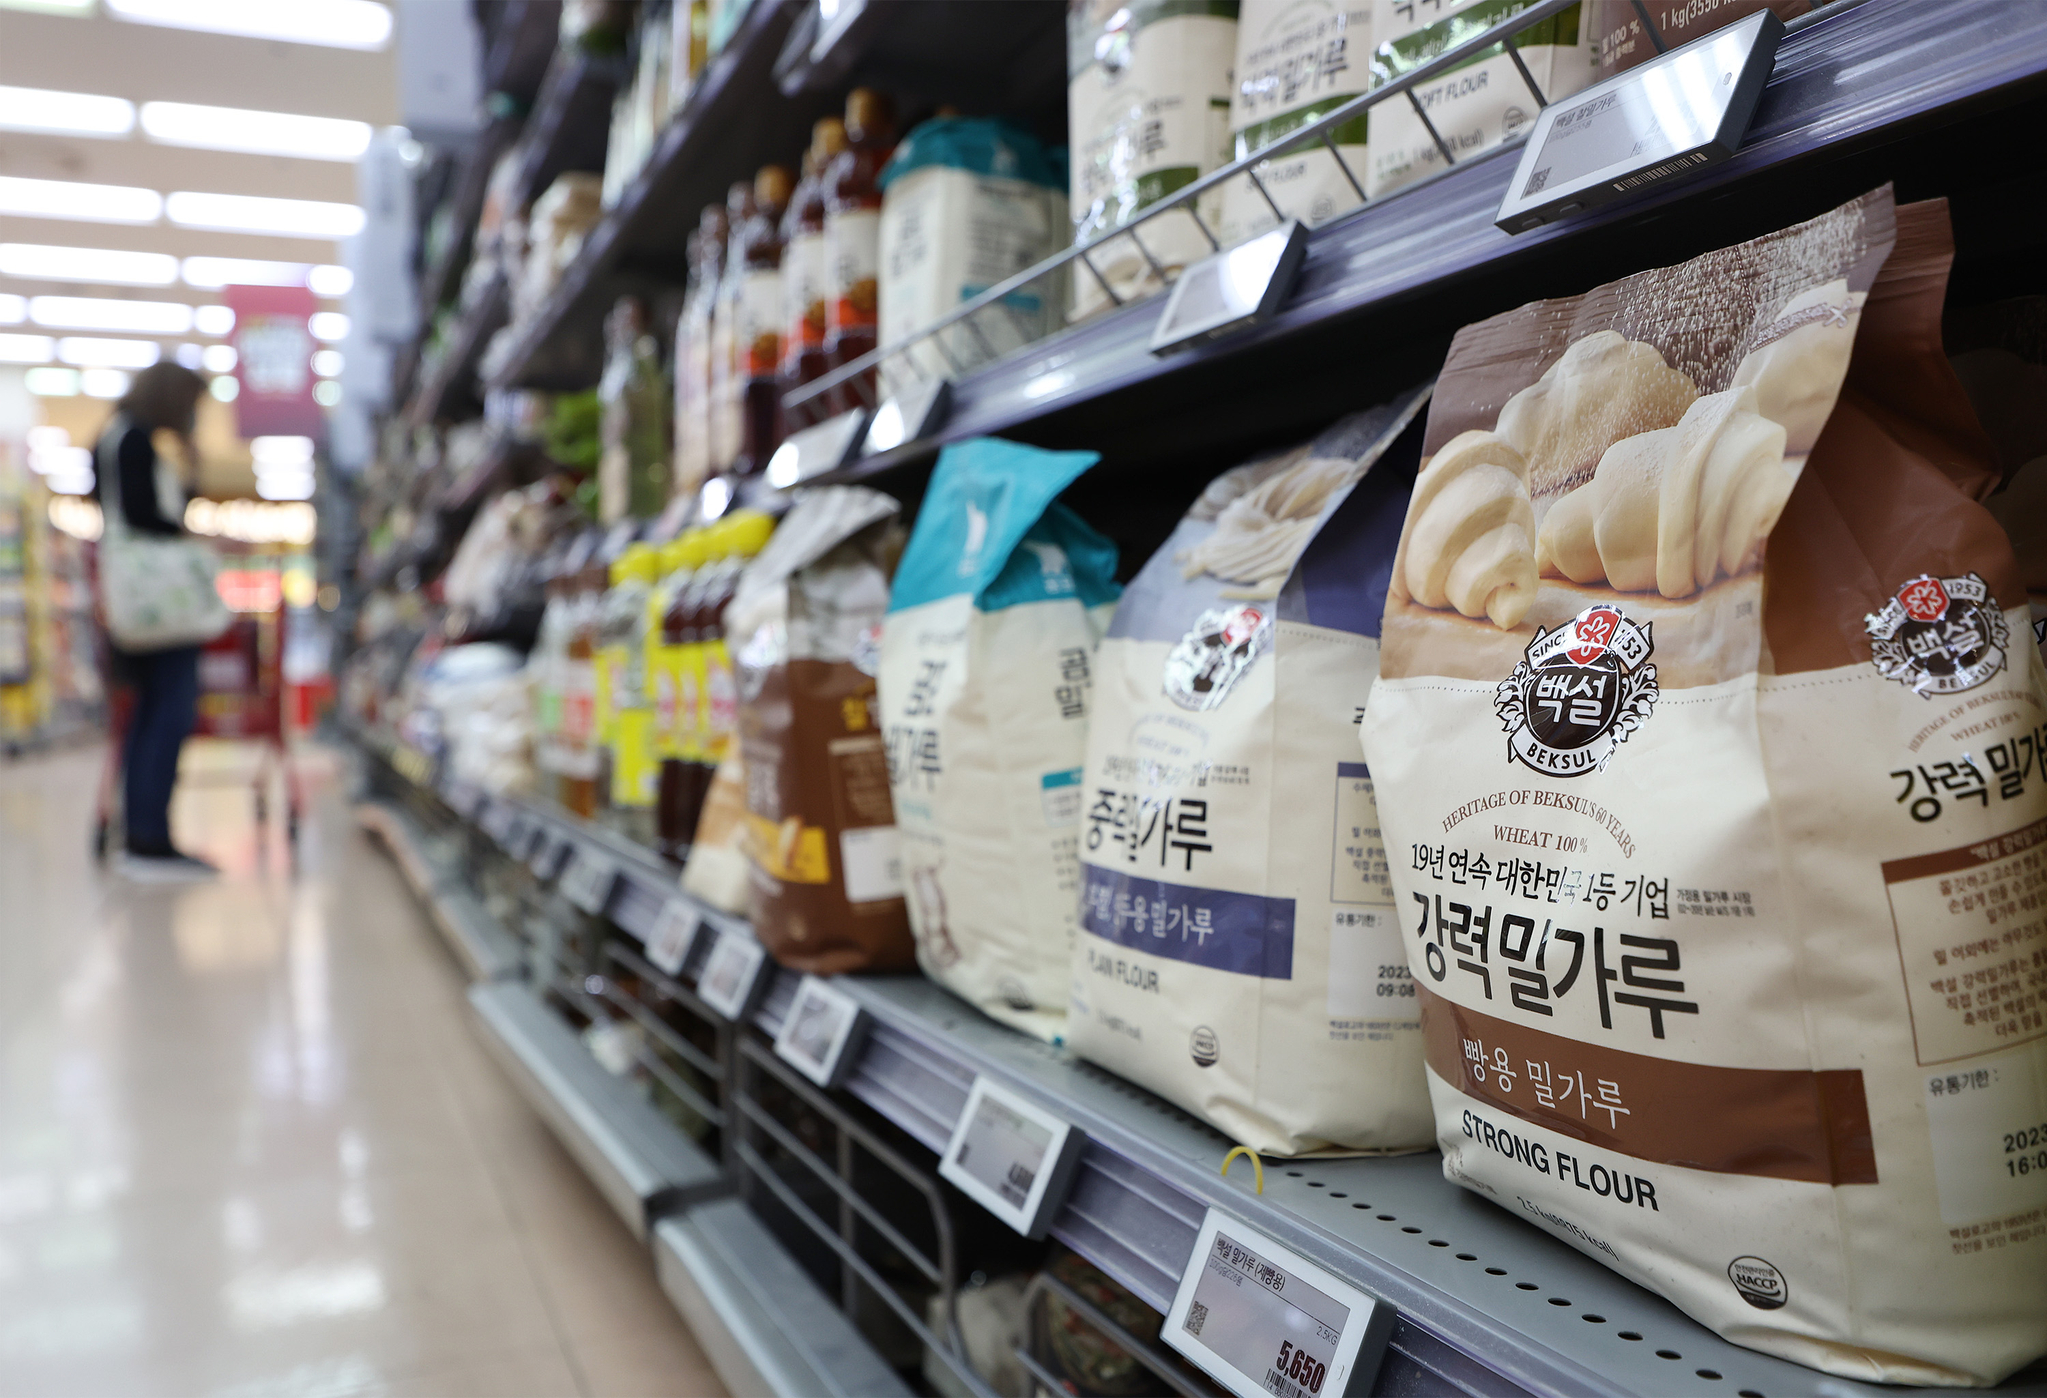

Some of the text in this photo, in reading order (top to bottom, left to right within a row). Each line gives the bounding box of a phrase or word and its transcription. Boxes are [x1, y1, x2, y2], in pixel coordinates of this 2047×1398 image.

[1445, 70, 1489, 101] FLOUR
[1907, 607, 1985, 661] 백설
[1536, 675, 1608, 728] 백설
[1526, 741, 1597, 770] BEKSUL
[1442, 791, 1507, 835] HERITAGE
[1509, 789, 1531, 806] OF
[1532, 790, 1597, 819] BEKSUL'S
[1605, 815, 1637, 860] YEARS
[1493, 825, 1553, 850] WHEAT
[1412, 843, 1445, 880] 19년
[1448, 848, 1492, 890] 연속
[1582, 872, 1617, 911] 1등
[1620, 874, 1670, 920] 기업
[1378, 964, 1411, 980] 2023
[1462, 1037, 1631, 1130] 빵용 밀가루
[1929, 1070, 1989, 1097] 유통기한
[1462, 1109, 1550, 1176] STRONG
[1556, 1151, 1660, 1212] FLOUR
[1217, 1238, 1233, 1260] 백설
[1254, 1261, 1286, 1292] (제빵용)
[1736, 1273, 1778, 1290] HACCP
[1315, 1325, 1338, 1346] 2.5KG
[1276, 1339, 1326, 1394] 5,650
